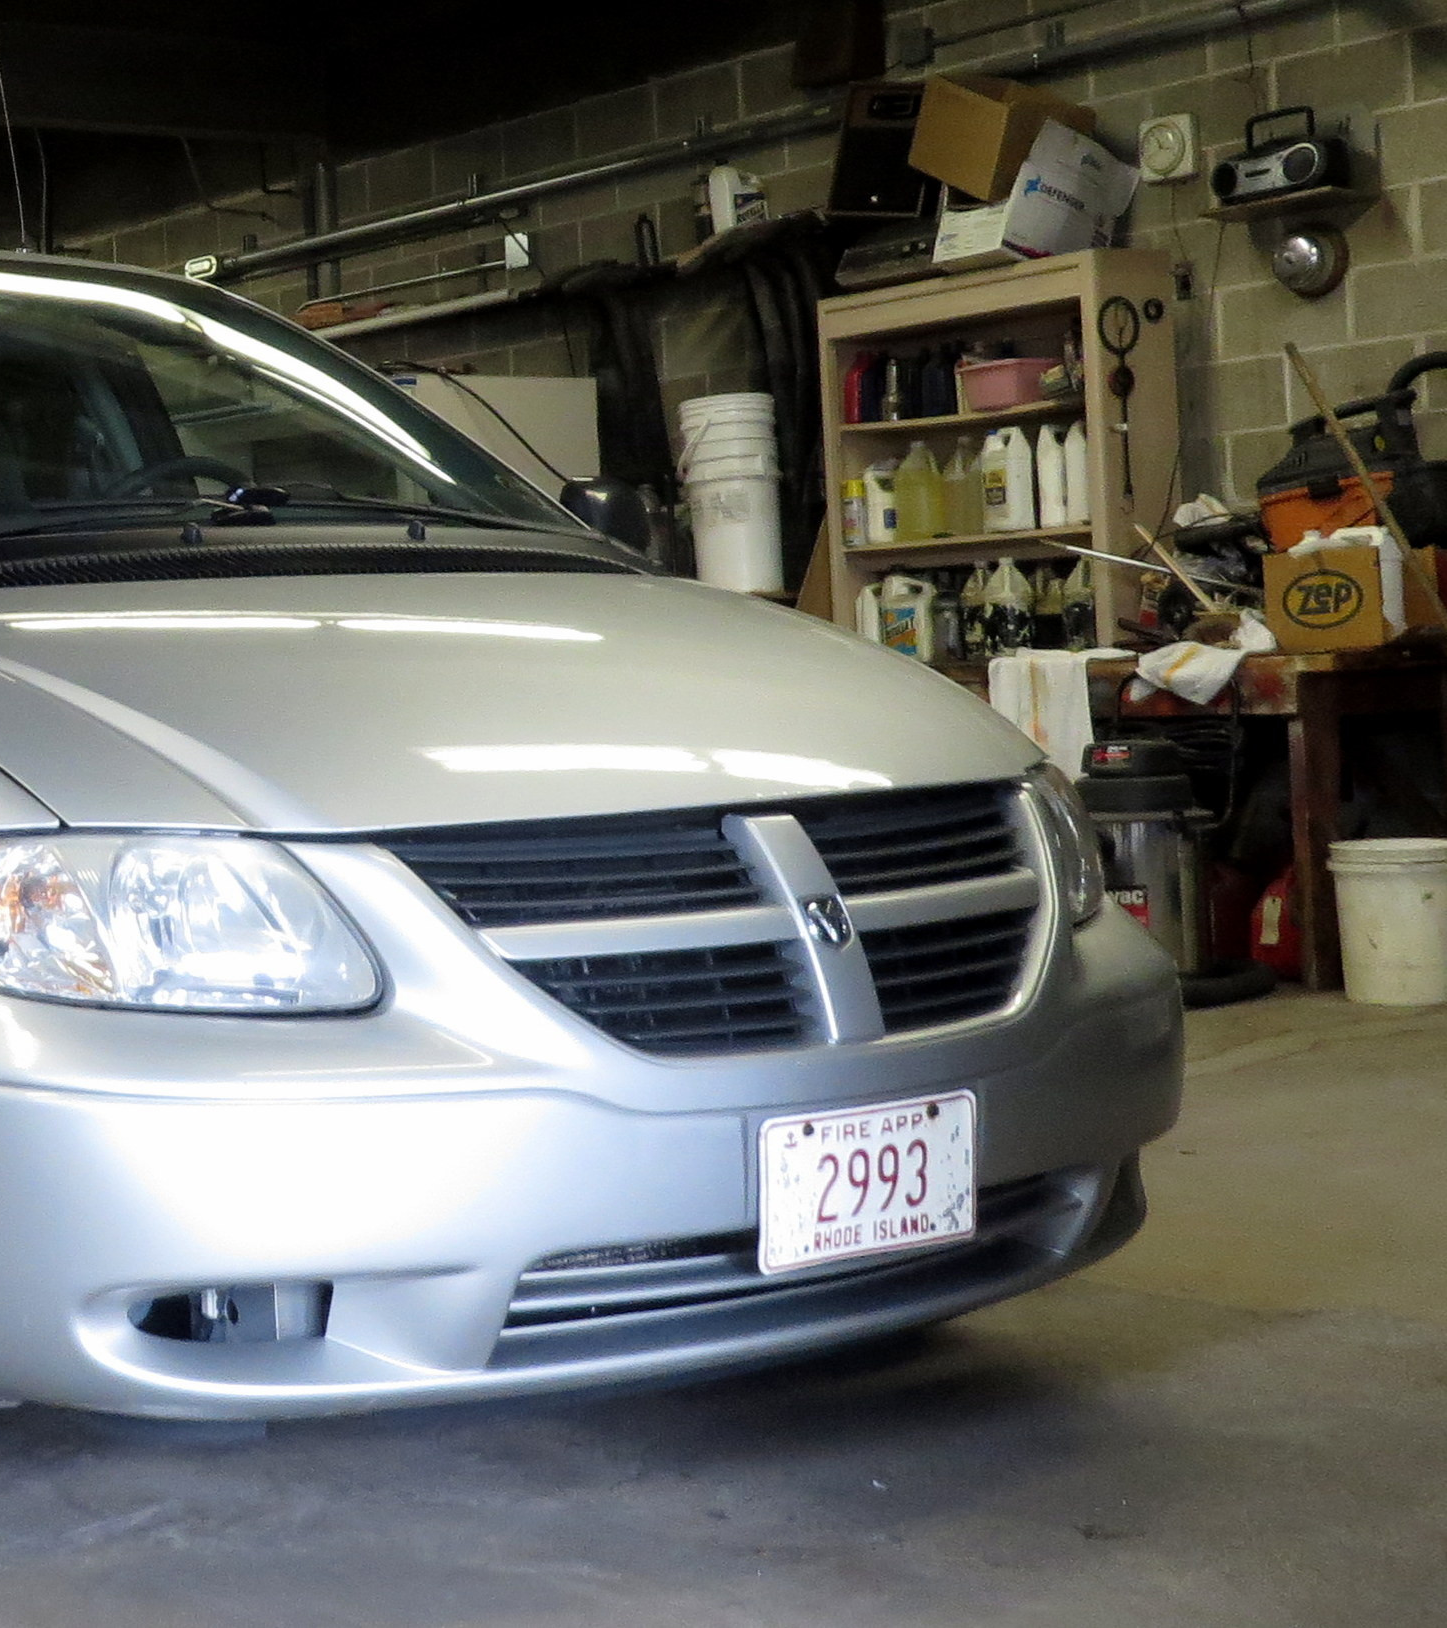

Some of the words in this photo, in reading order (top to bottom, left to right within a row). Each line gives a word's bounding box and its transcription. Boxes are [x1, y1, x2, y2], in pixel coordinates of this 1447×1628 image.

[820, 1120, 872, 1145] FIRE
[817, 1139, 928, 1223] 2993
[813, 1223, 863, 1252] RHODE
[873, 1212, 931, 1241] ISLAND
